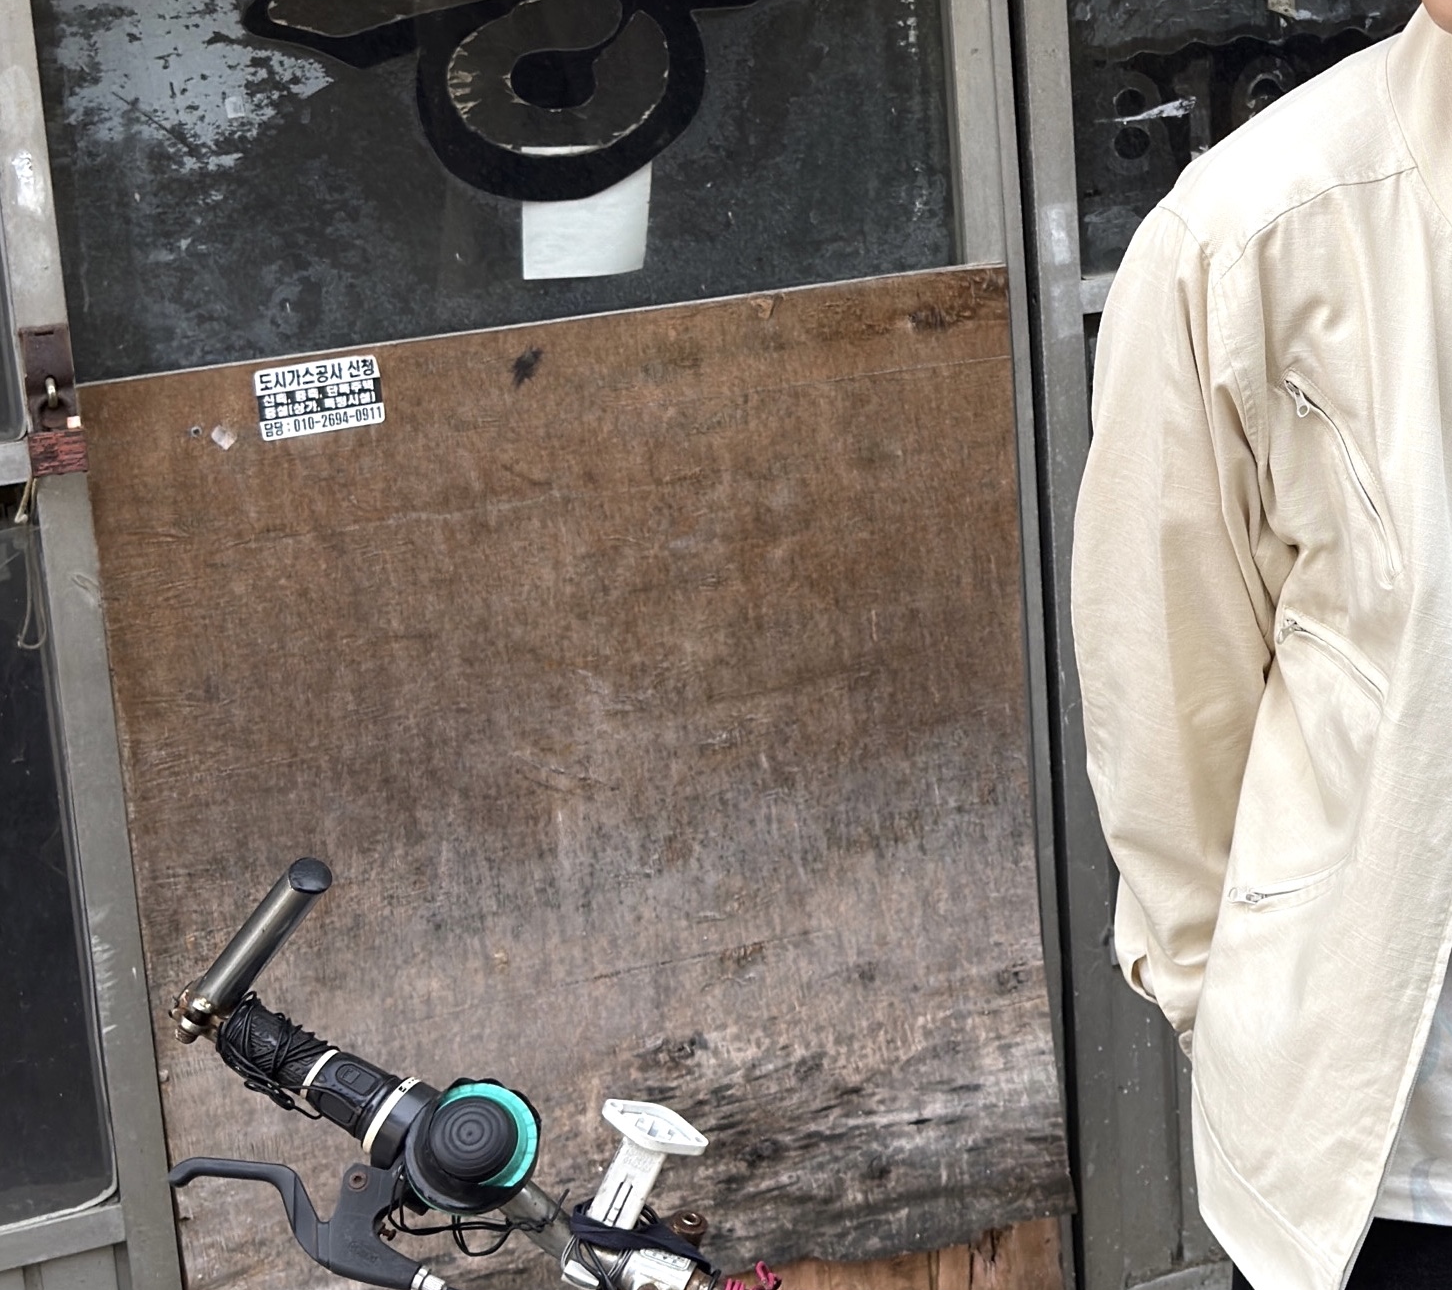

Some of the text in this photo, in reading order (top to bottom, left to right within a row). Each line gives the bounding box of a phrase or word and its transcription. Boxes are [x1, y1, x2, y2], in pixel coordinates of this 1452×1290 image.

[259, 359, 375, 391] 도시가스공사 신청
[293, 406, 382, 433] 010-2694-0911
